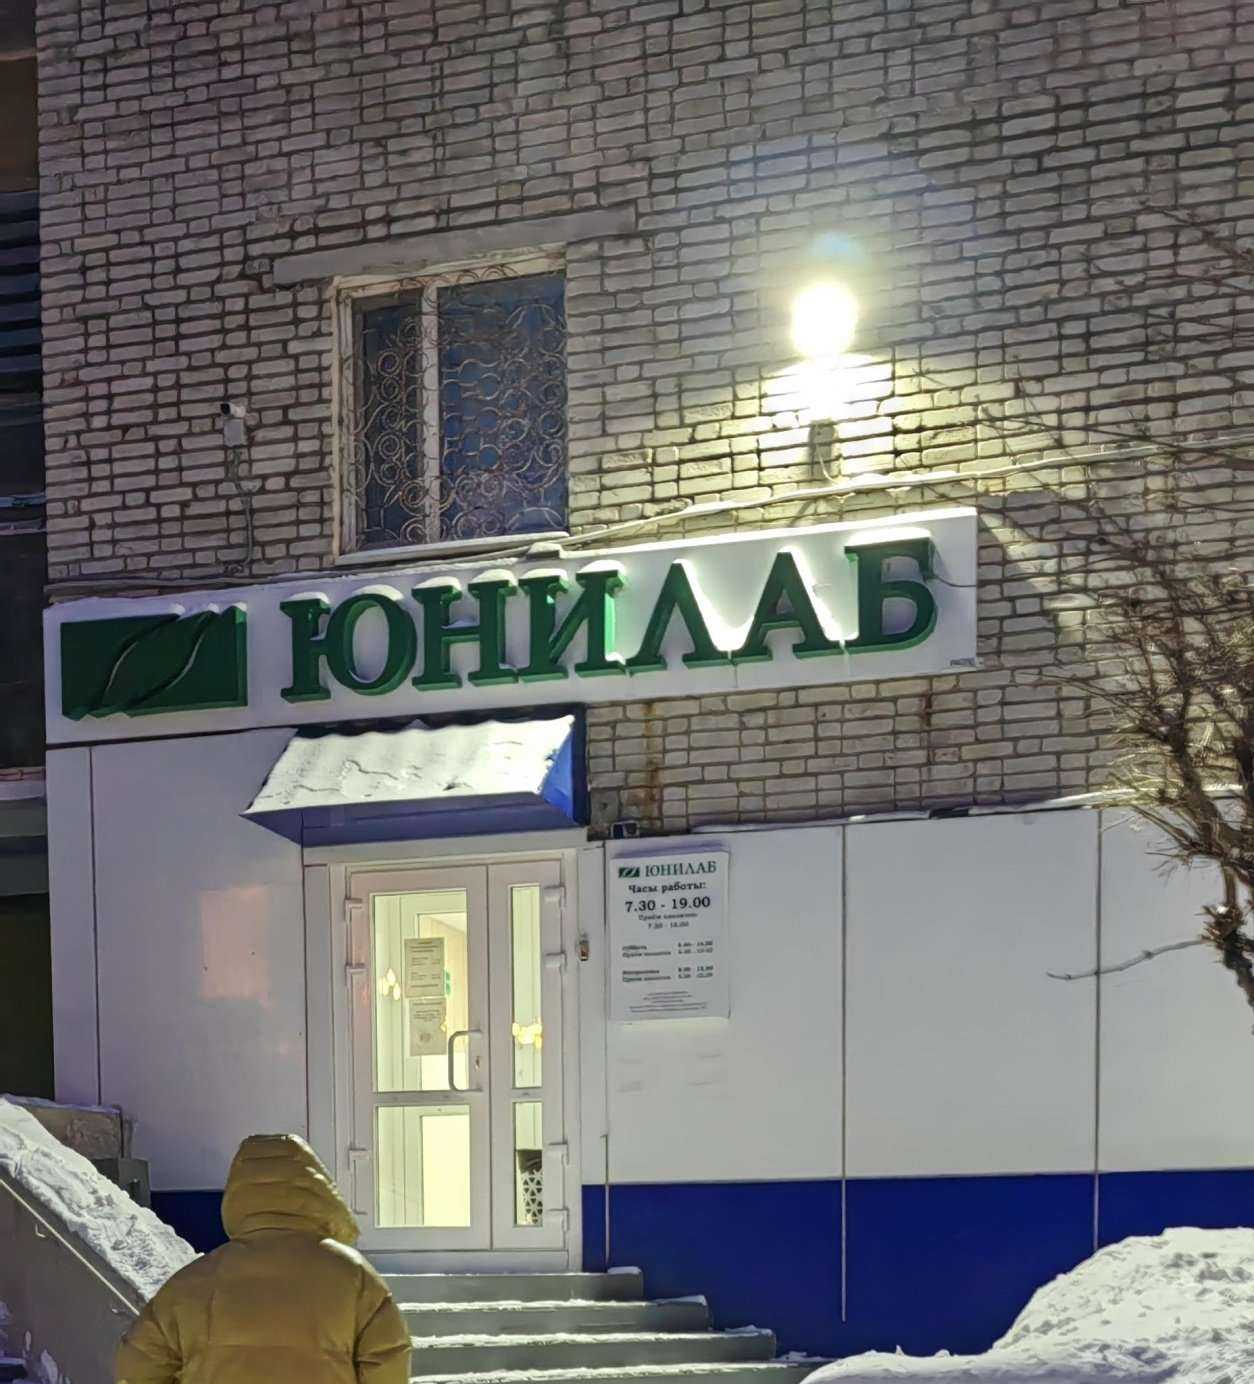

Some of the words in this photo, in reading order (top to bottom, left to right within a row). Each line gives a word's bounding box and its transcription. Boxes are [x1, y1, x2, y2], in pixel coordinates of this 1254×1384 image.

[280, 536, 936, 702] ЮНИЛАБ
[645, 861, 717, 877] ЮНИЛАБ
[628, 884, 658, 893] Часы
[661, 881, 706, 894] работы:
[625, 900, 656, 912] 7.30
[672, 896, 711, 909] 19.00
